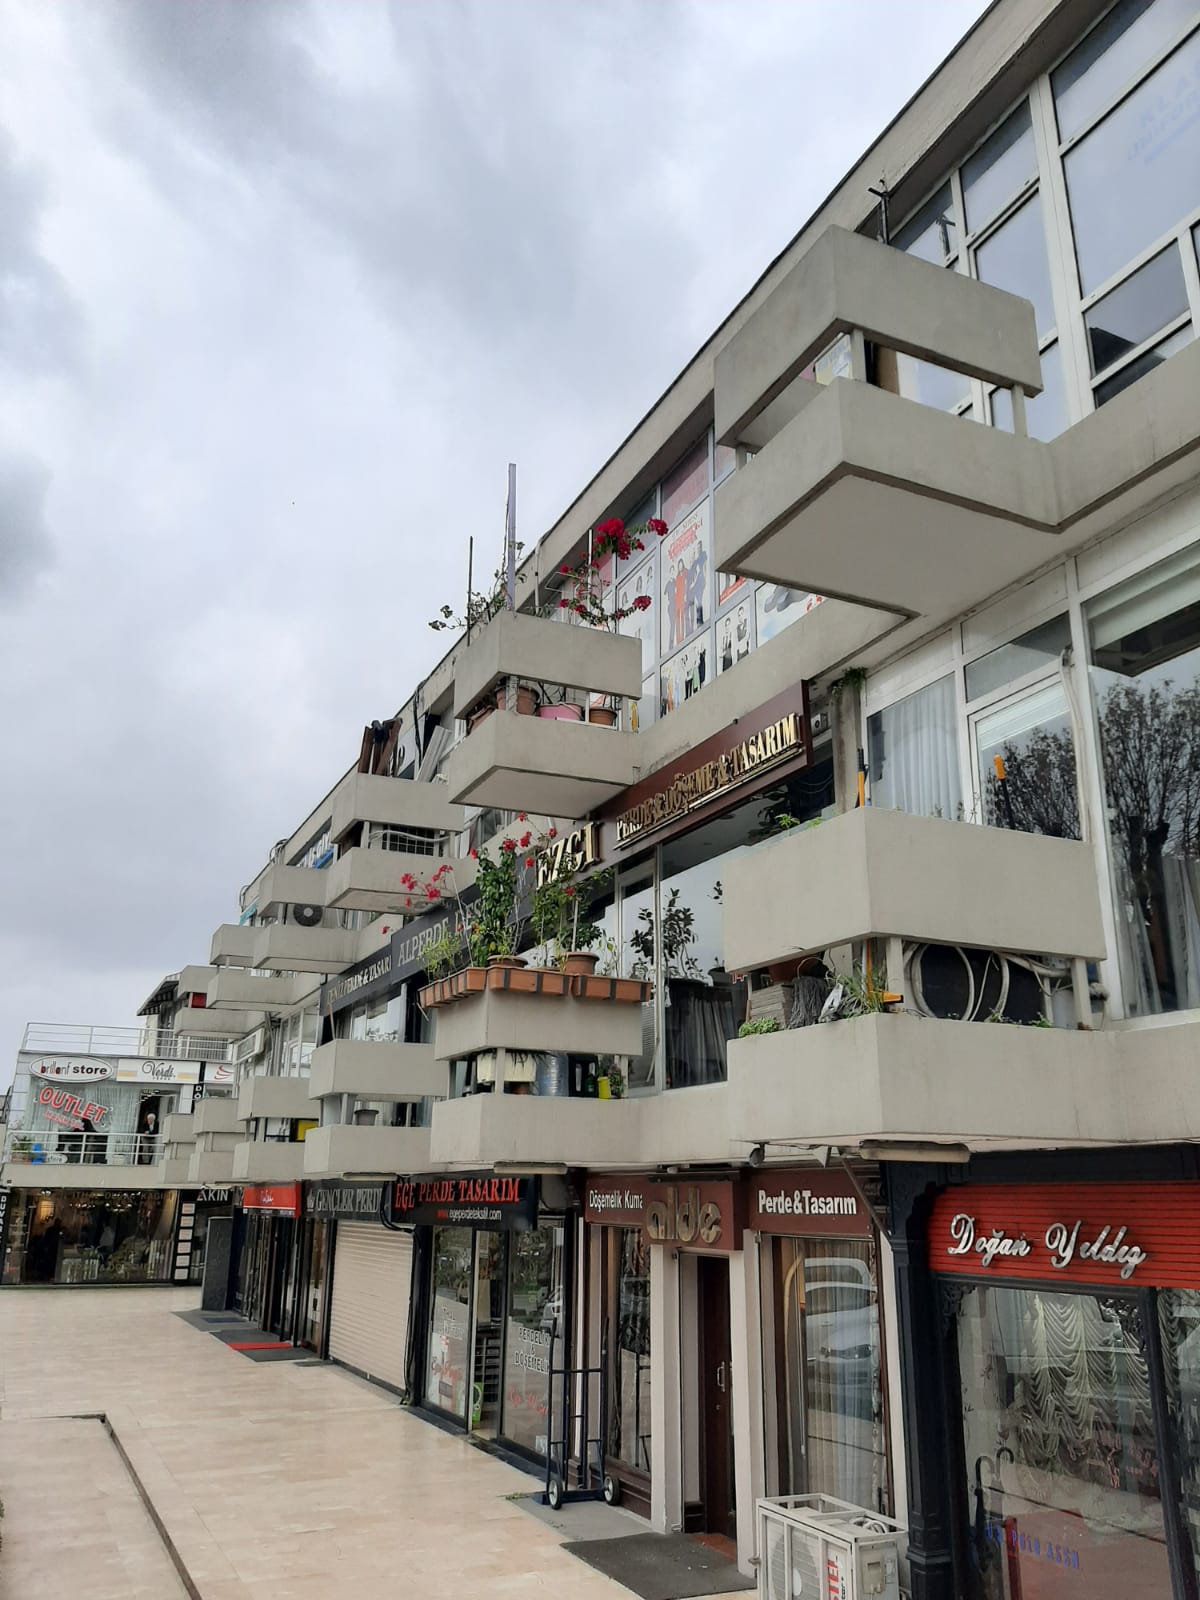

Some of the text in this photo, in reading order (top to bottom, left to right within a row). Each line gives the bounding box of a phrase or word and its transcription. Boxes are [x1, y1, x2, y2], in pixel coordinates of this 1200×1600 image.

[729, 713, 798, 779] TASARIM
[368, 955, 391, 981] TASARI
[72, 1064, 108, 1076] store
[141, 1060, 174, 1079] Verdi
[39, 1086, 109, 1123] OUTLET
[196, 1188, 229, 1202] AKIN
[315, 1188, 383, 1218] GENÇLER PERD
[394, 1177, 520, 1213] EGE PERDE TASARIM
[589, 1189, 643, 1212] Döşemelik Kuma
[947, 1213, 1031, 1267] Doğan
